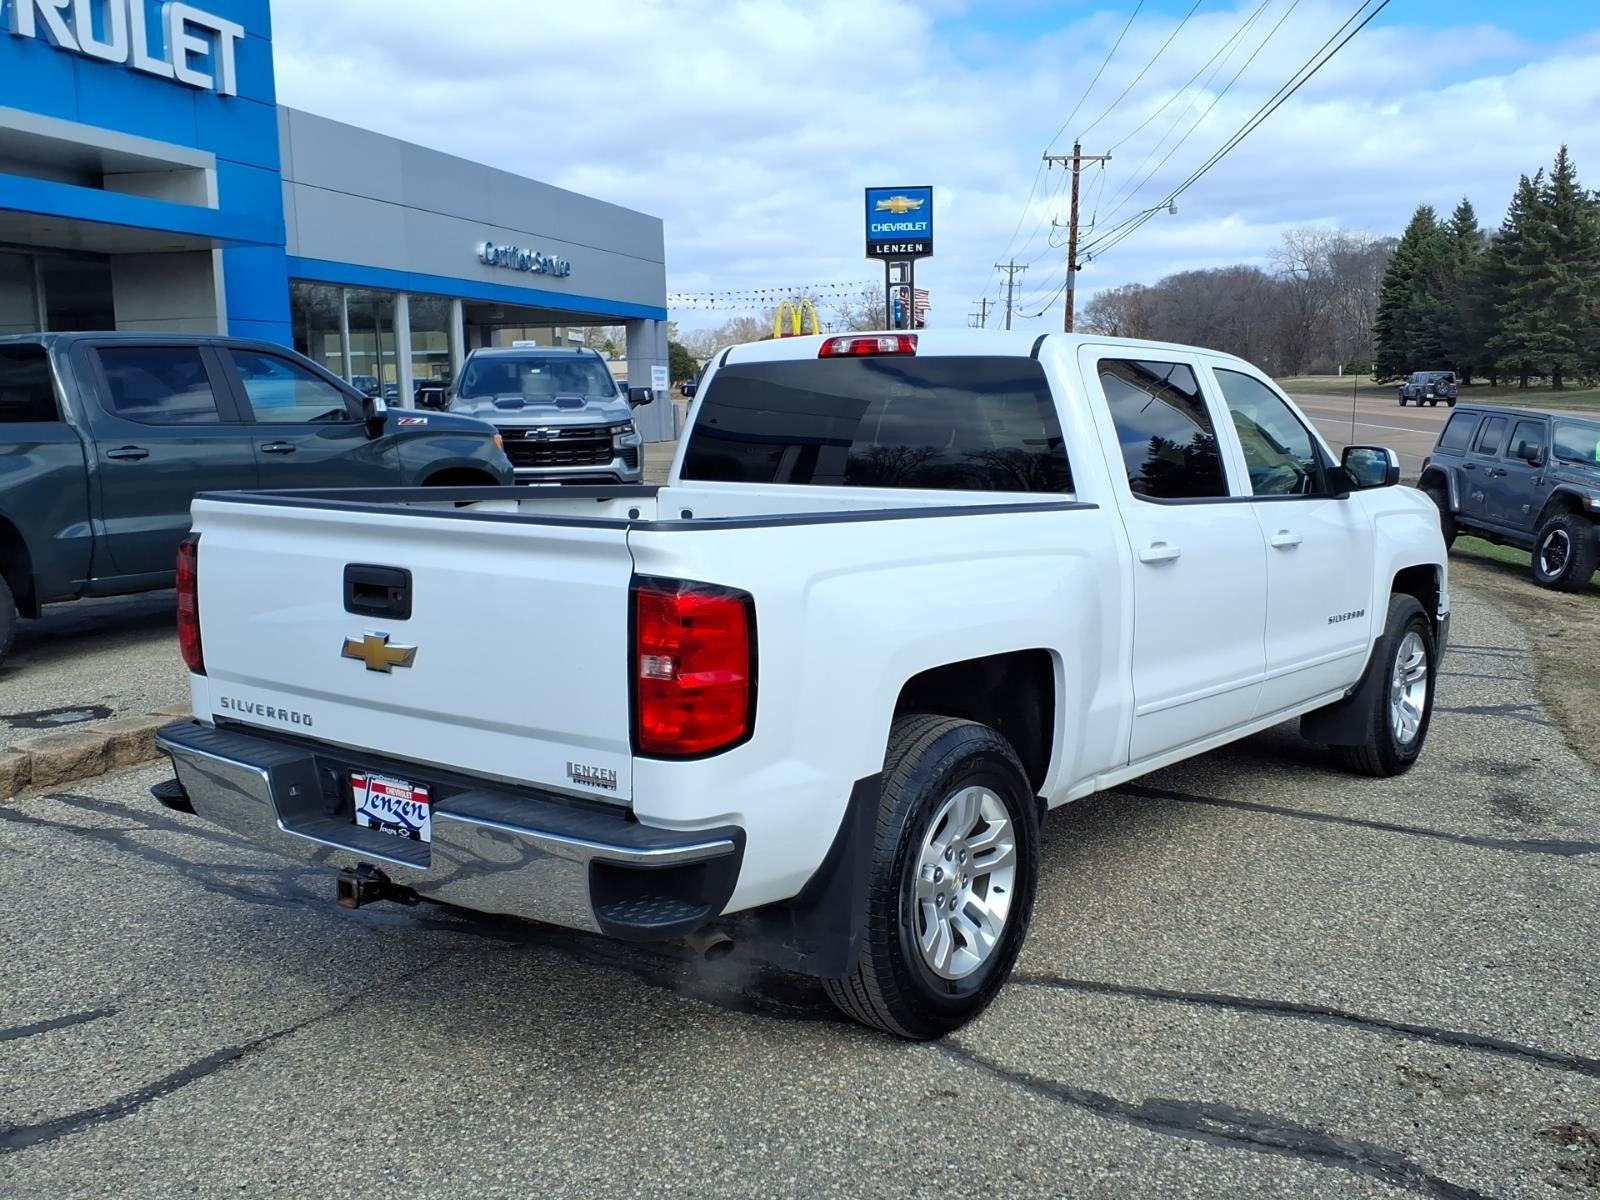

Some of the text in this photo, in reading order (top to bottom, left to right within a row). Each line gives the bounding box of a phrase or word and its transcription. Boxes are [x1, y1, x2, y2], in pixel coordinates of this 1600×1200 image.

[871, 221, 928, 232] CHEVROLET
[876, 243, 923, 253] LENZEN
[480, 241, 571, 278] Certified Service
[220, 696, 313, 727] SILVERADO
[566, 761, 617, 783] LENZEN
[356, 776, 428, 831] Lenzen
[385, 786, 412, 800] CHEVROLET
